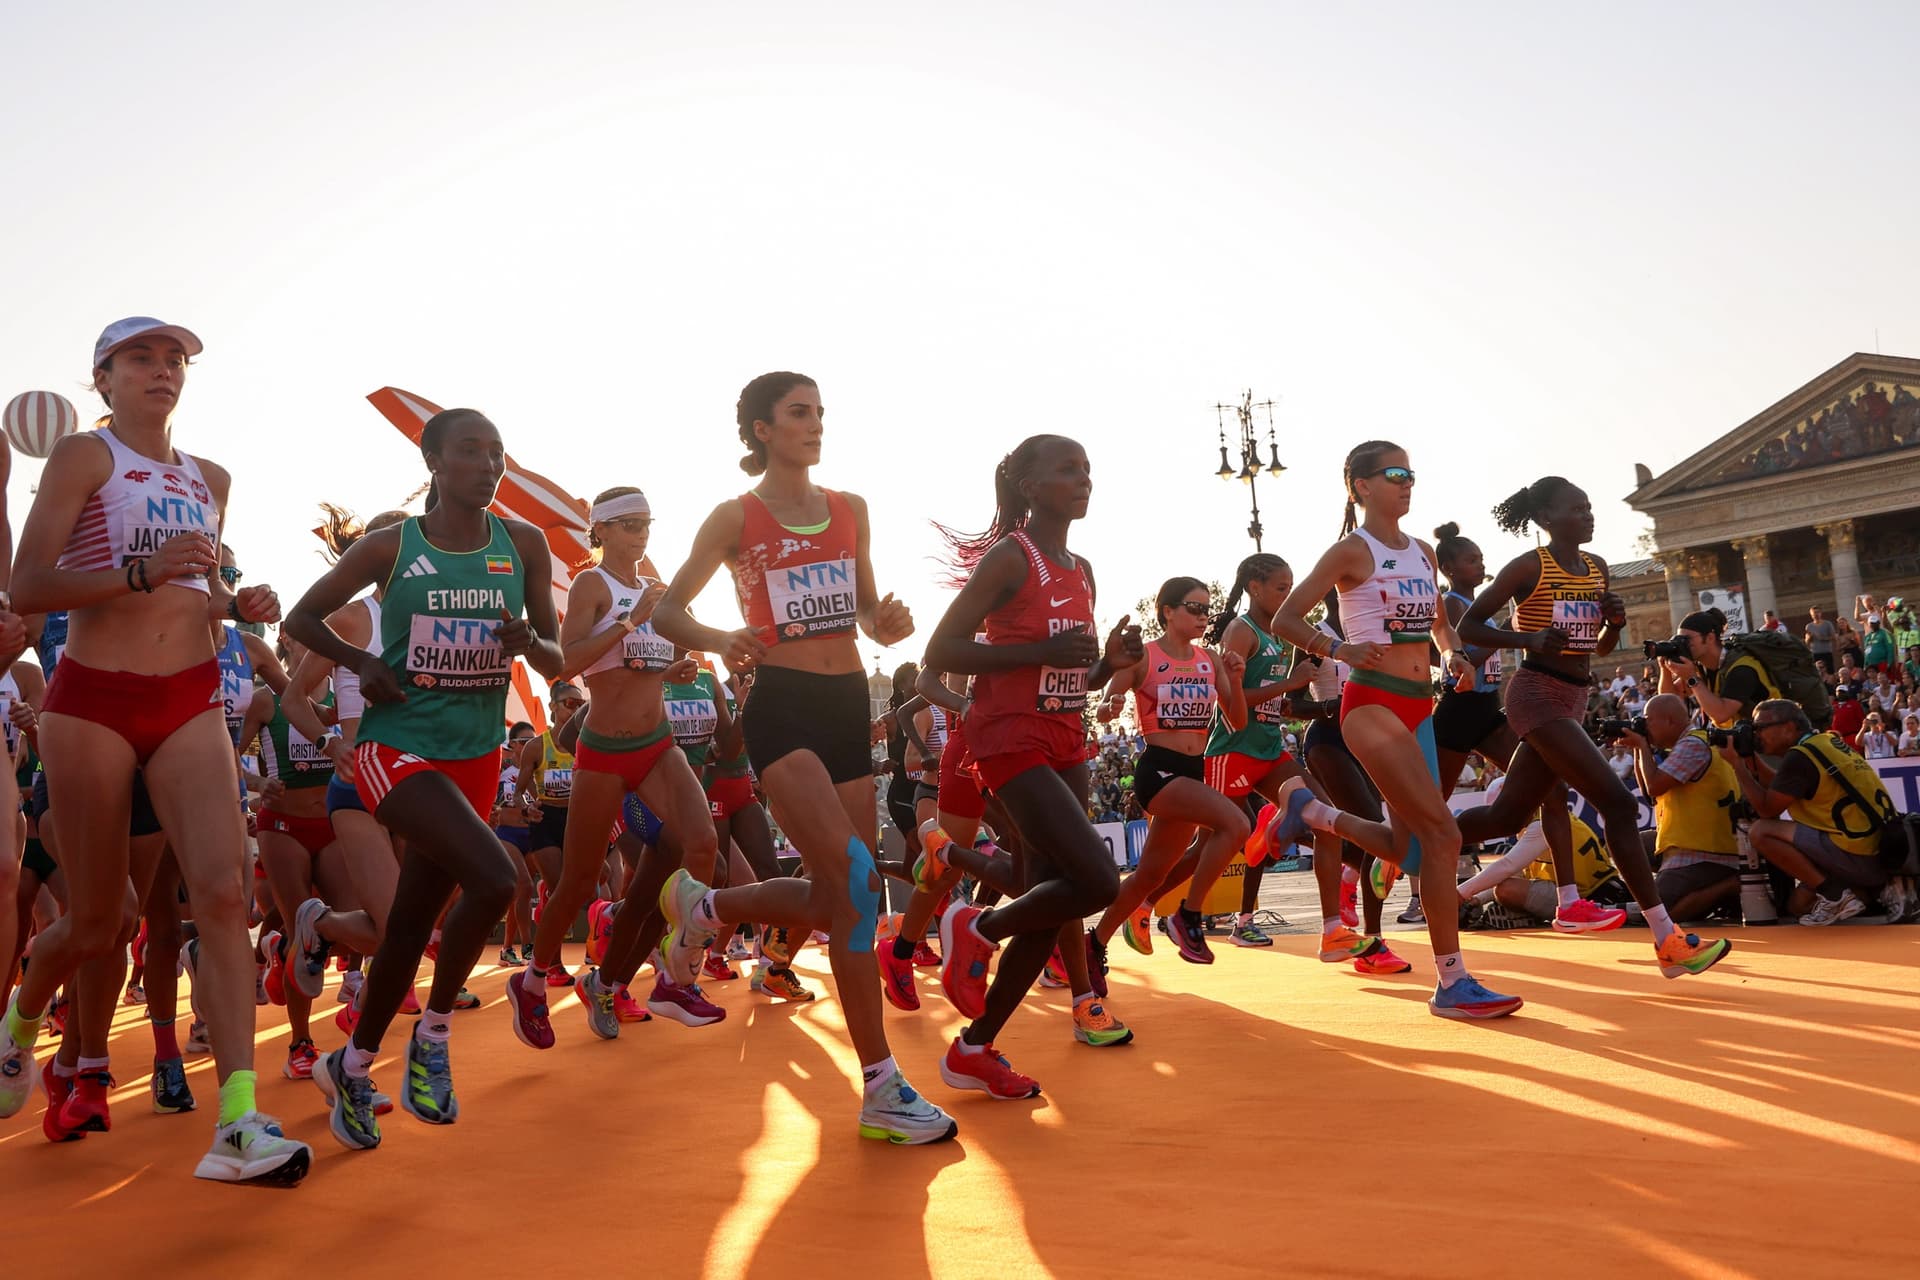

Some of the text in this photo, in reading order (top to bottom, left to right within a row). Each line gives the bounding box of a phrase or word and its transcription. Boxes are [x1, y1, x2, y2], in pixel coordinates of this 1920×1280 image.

[147, 496, 205, 526] NTN
[787, 560, 849, 592] NTN
[1398, 579, 1434, 597] NTN
[427, 589, 505, 610] ETHIOPIA
[785, 592, 854, 620] GÖNEN
[413, 645, 507, 671] SHANKULE
[440, 677, 506, 687] BUDAPEST 23
[1171, 685, 1208, 699] NTN
[671, 701, 709, 716] NTN
[1162, 702, 1211, 716] KASEDA
